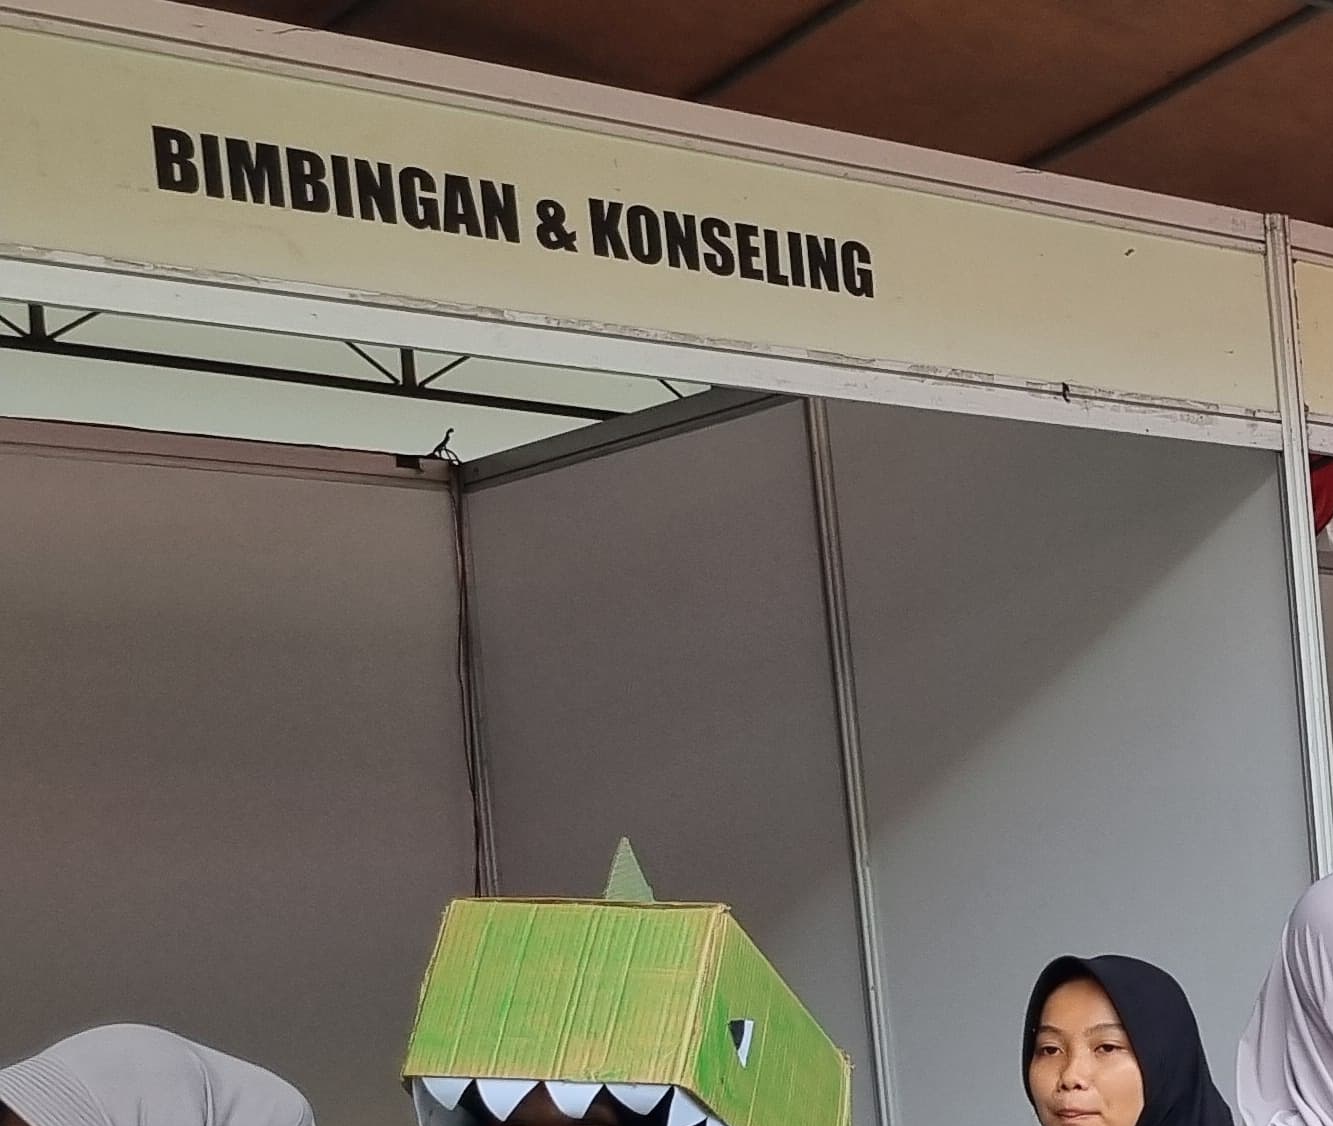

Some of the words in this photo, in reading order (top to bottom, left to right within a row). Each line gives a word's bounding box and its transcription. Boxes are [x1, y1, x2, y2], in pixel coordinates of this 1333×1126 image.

[151, 125, 520, 243] BIMBINGAN
[535, 199, 577, 252] &
[588, 198, 874, 298] KONSELING
